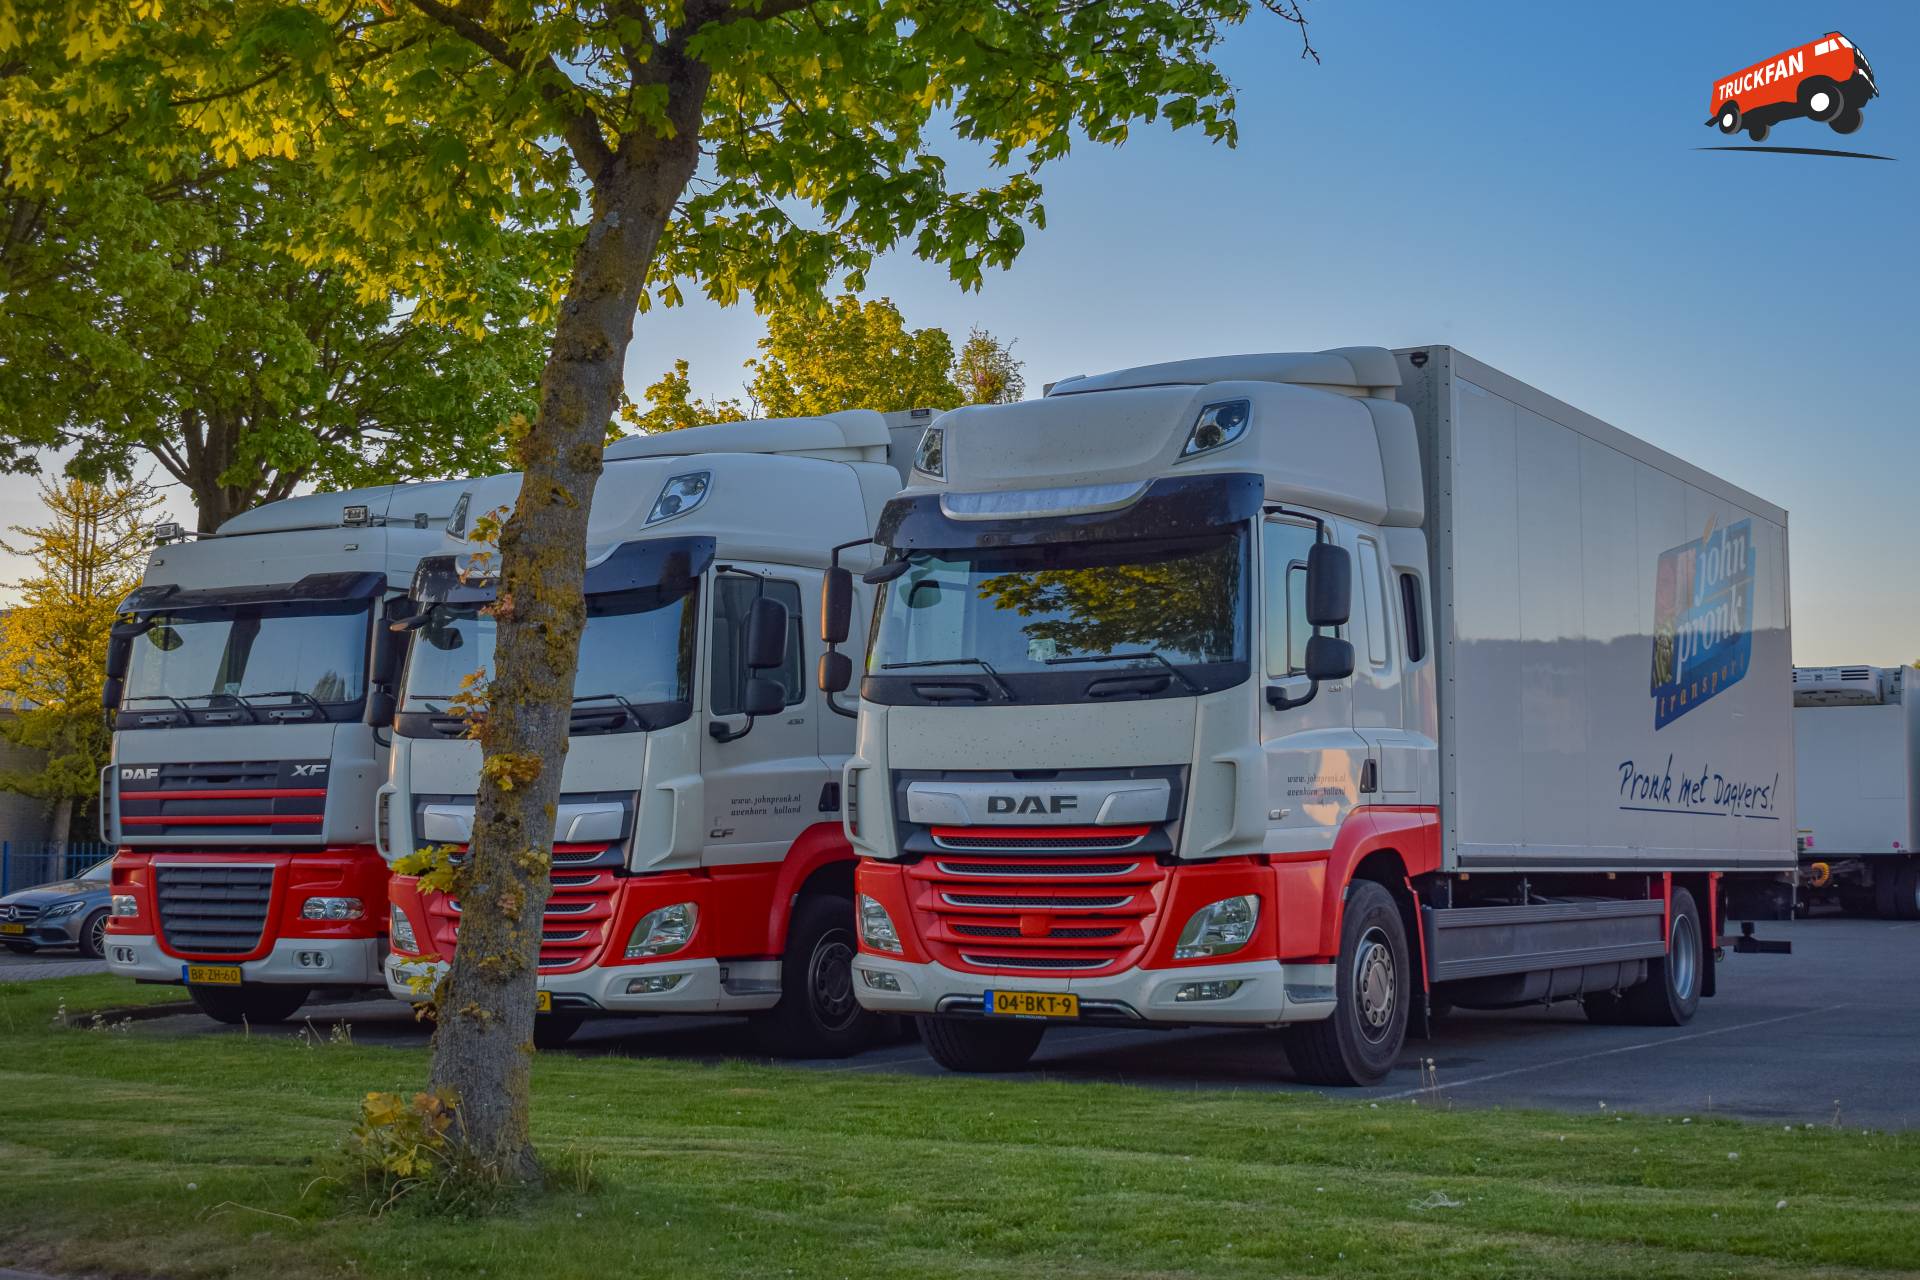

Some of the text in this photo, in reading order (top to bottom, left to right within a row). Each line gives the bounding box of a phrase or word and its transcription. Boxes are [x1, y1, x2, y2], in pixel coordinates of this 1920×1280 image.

[1694, 528, 1746, 607] john
[1676, 584, 1742, 685] pronk
[121, 768, 159, 780] DAF
[291, 764, 327, 776] XF
[1619, 753, 1673, 804] Pronk
[1678, 763, 1708, 807] met
[987, 795, 1078, 814] DAF
[710, 828, 736, 838] CF
[998, 994, 1072, 1014] 04-BKT-9
